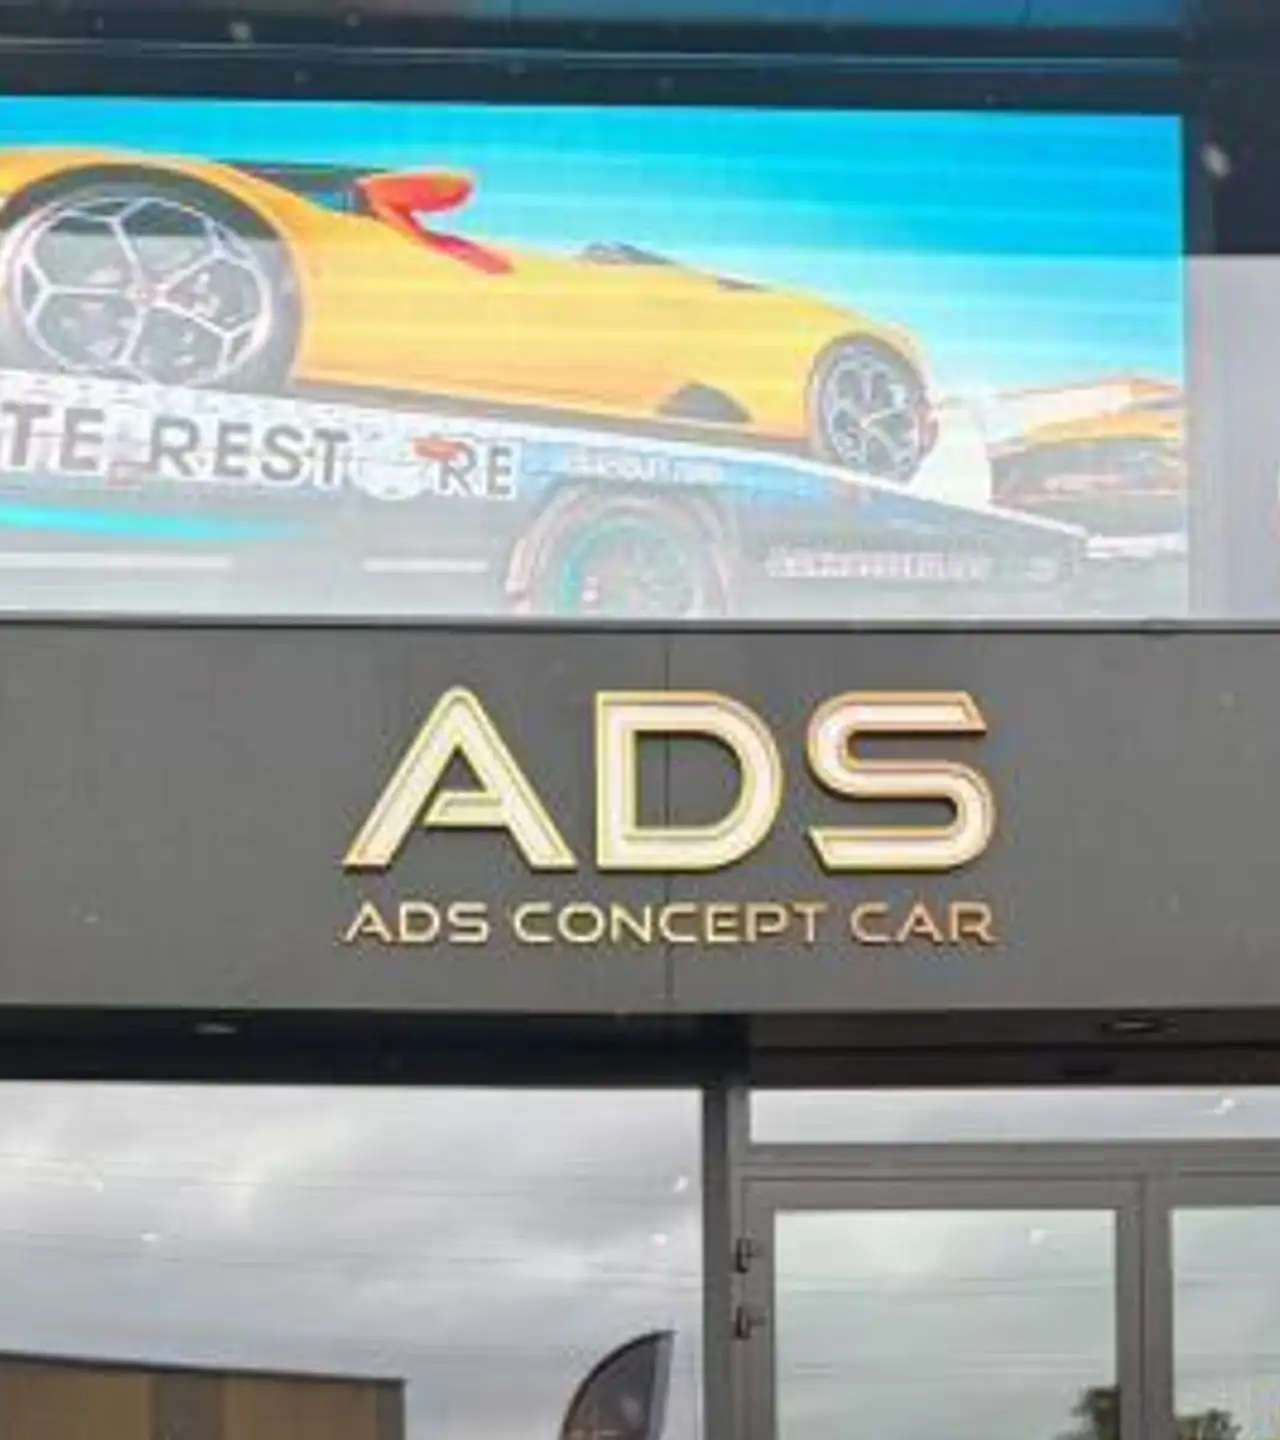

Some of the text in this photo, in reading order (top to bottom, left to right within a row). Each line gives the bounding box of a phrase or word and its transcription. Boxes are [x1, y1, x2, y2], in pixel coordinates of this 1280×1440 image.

[149, 414, 514, 496] RESTRE
[342, 686, 995, 871] ADS
[343, 902, 997, 943] ADS CONCEPT CAR
